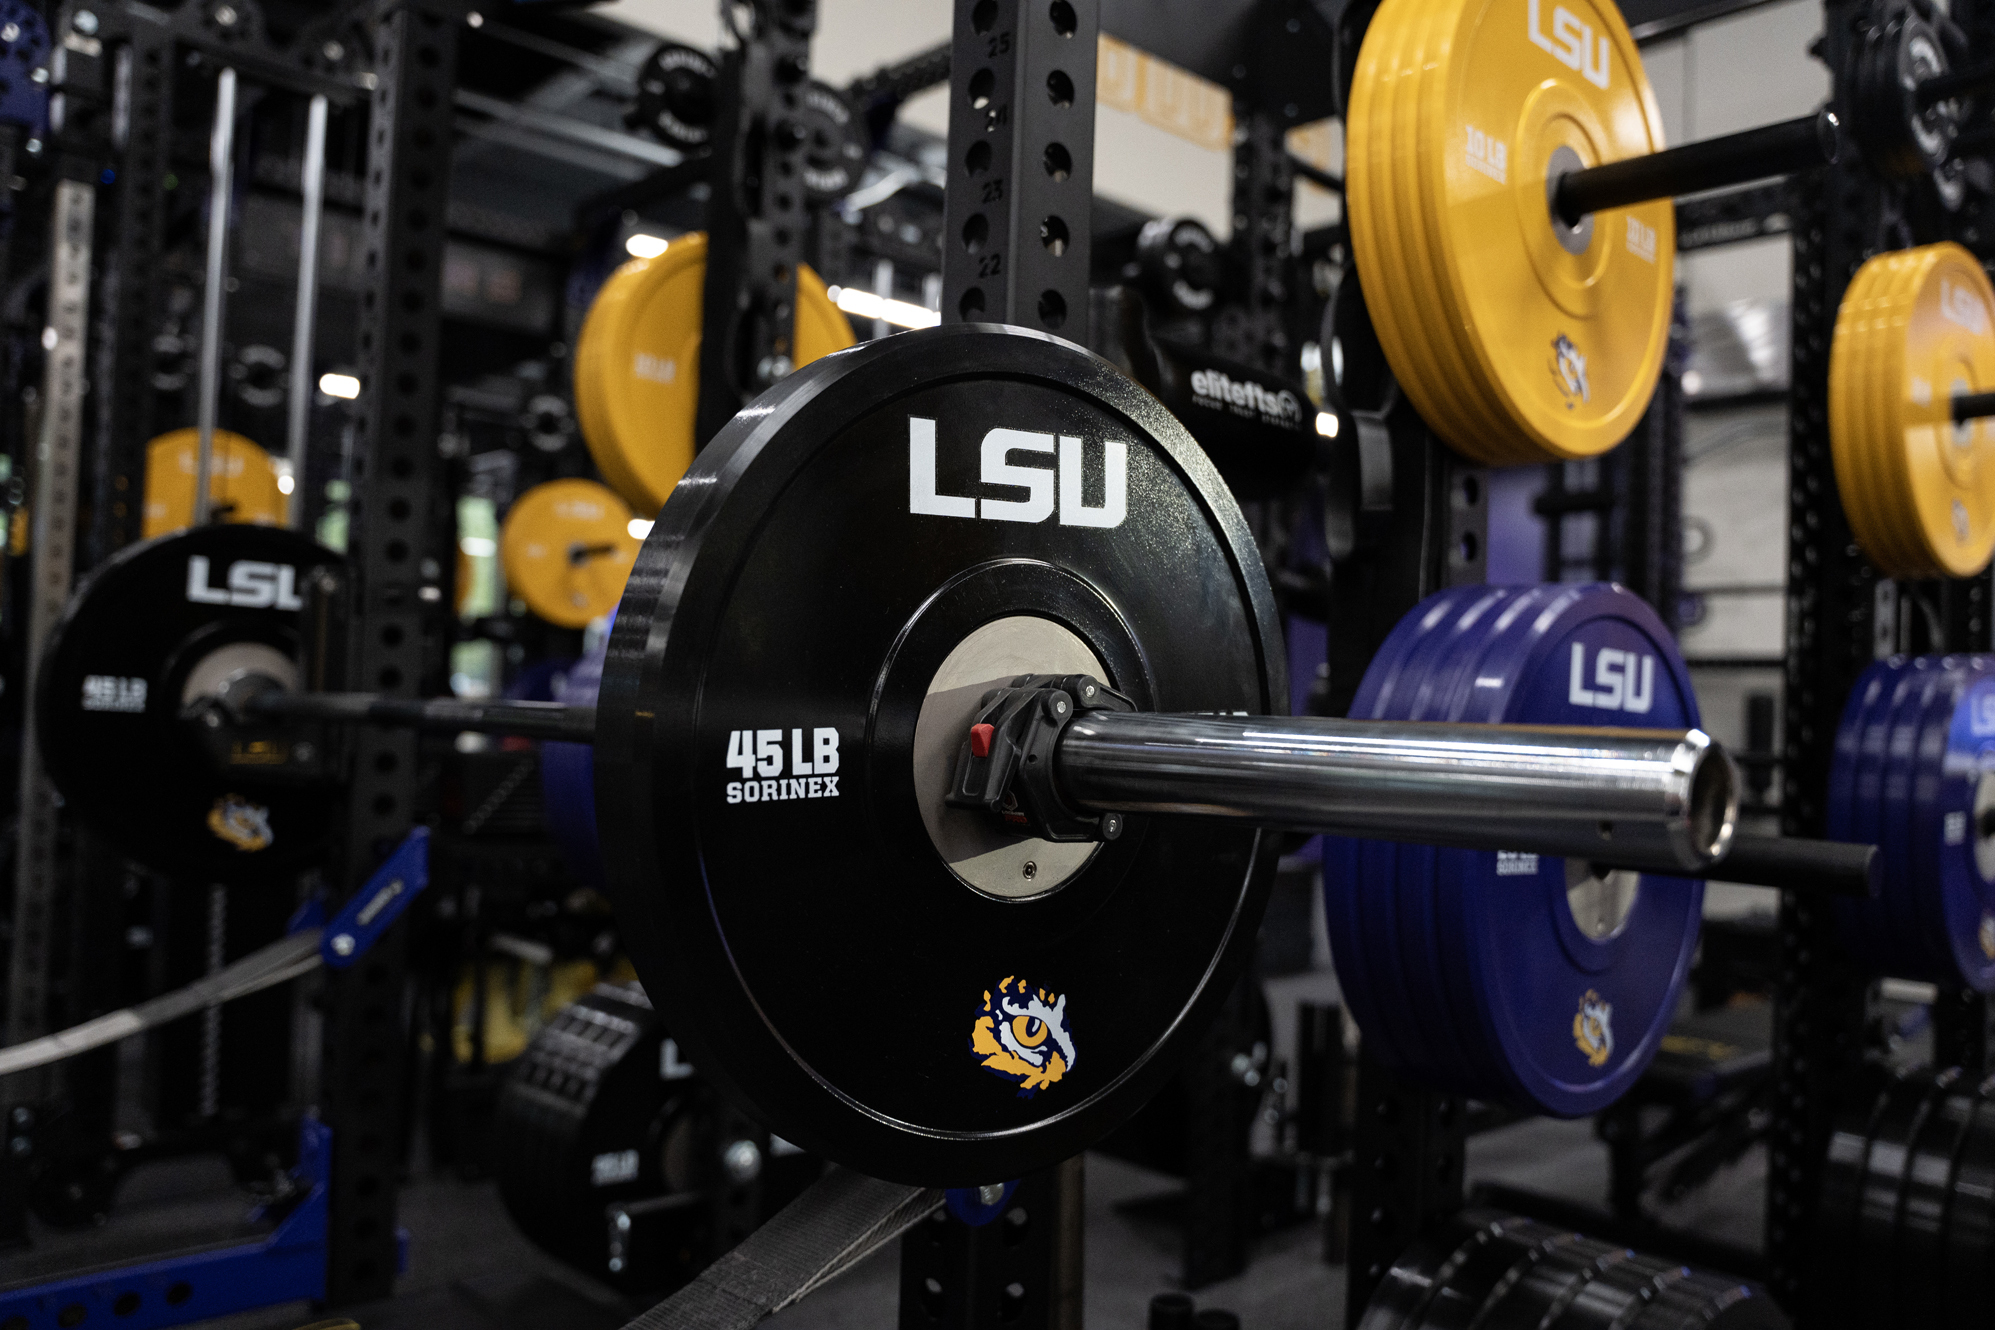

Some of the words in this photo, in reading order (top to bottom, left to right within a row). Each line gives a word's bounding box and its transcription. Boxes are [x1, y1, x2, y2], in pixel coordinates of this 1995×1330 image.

[987, 31, 1010, 58] 25
[1527, 0, 1609, 90] LSU
[982, 179, 1003, 204] 23
[979, 254, 1000, 279] 22
[1190, 369, 1281, 416] elitefts
[909, 415, 1127, 529] LSU
[1569, 641, 1655, 714] LSU
[726, 729, 783, 778] 45
[792, 727, 839, 775] LB
[726, 776, 839, 804] SORINEX
